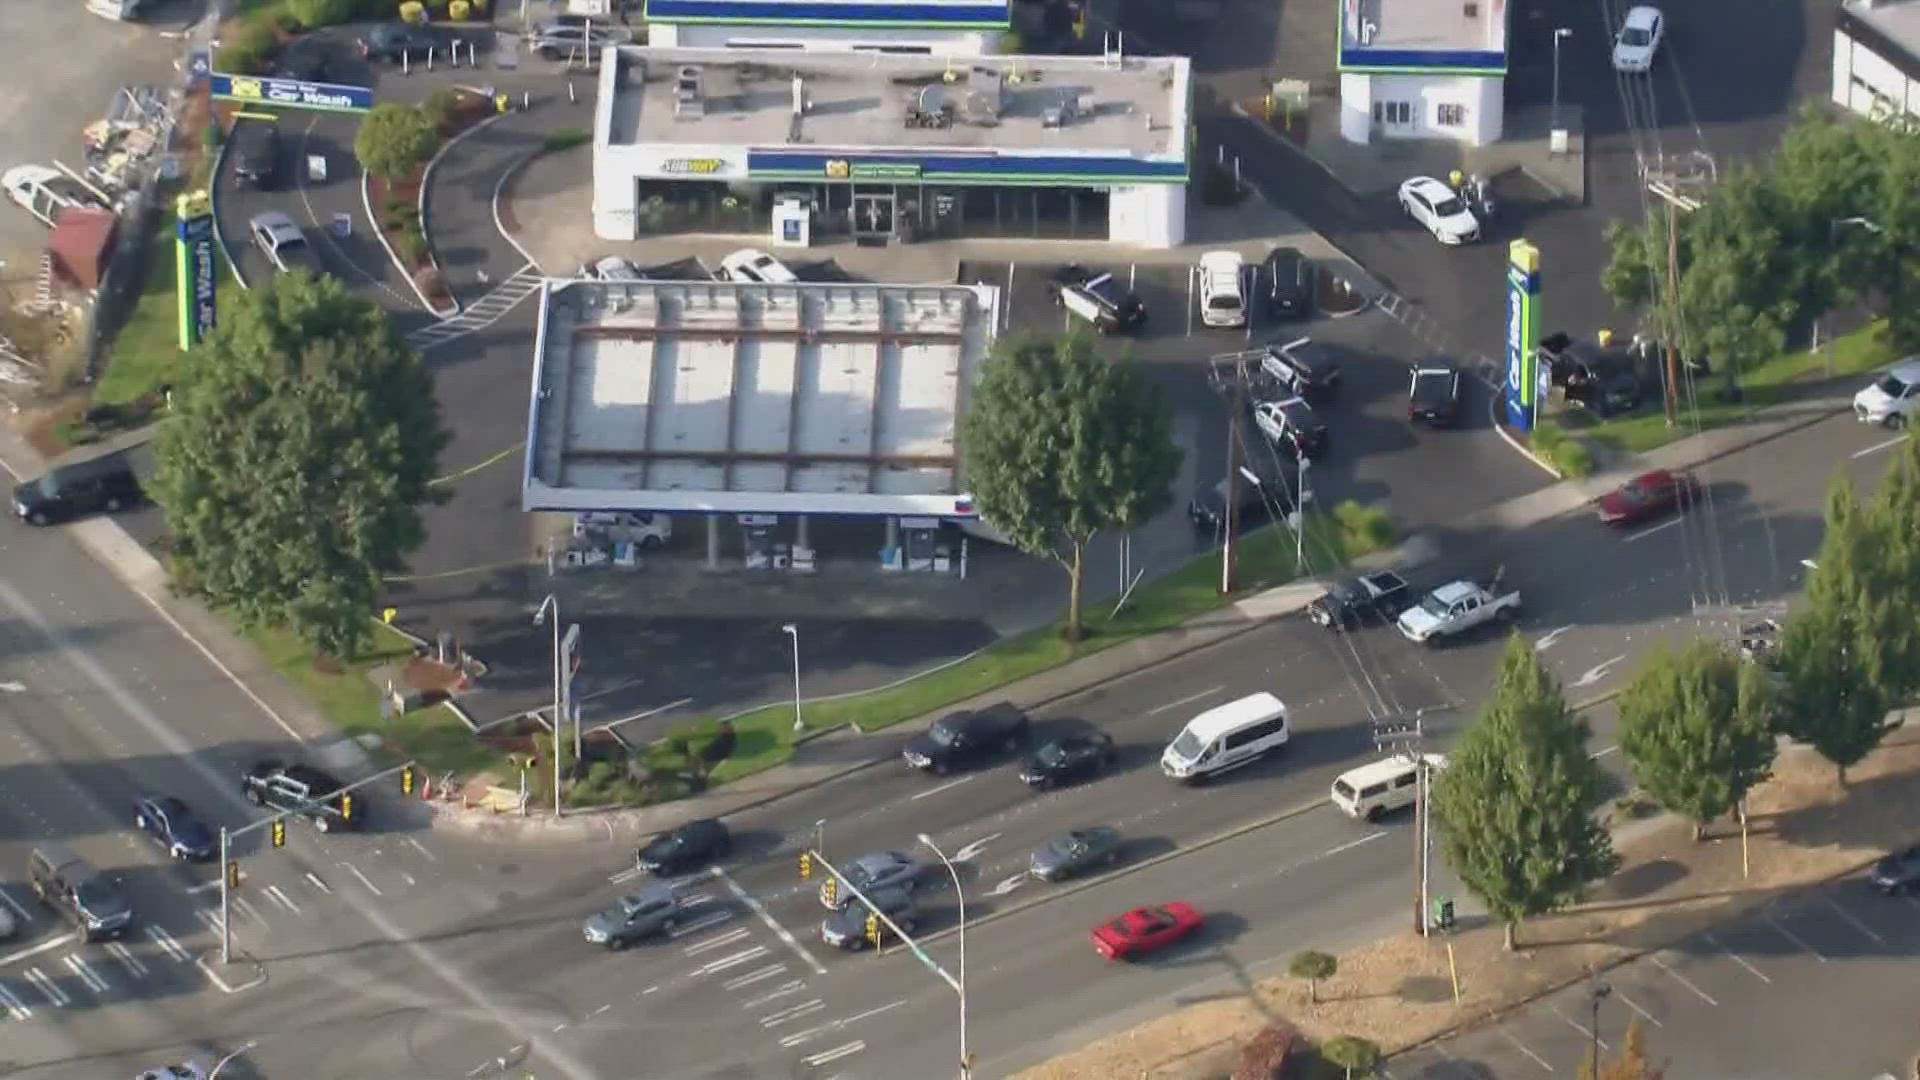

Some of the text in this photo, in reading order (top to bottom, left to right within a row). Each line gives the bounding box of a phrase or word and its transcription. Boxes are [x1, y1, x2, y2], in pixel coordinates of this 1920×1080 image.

[269, 89, 351, 106] Car Wash
[662, 159, 721, 173] SUBWAY
[196, 240, 211, 298] Wash
[1510, 290, 1520, 349] Wash
[1509, 349, 1520, 390] Car
